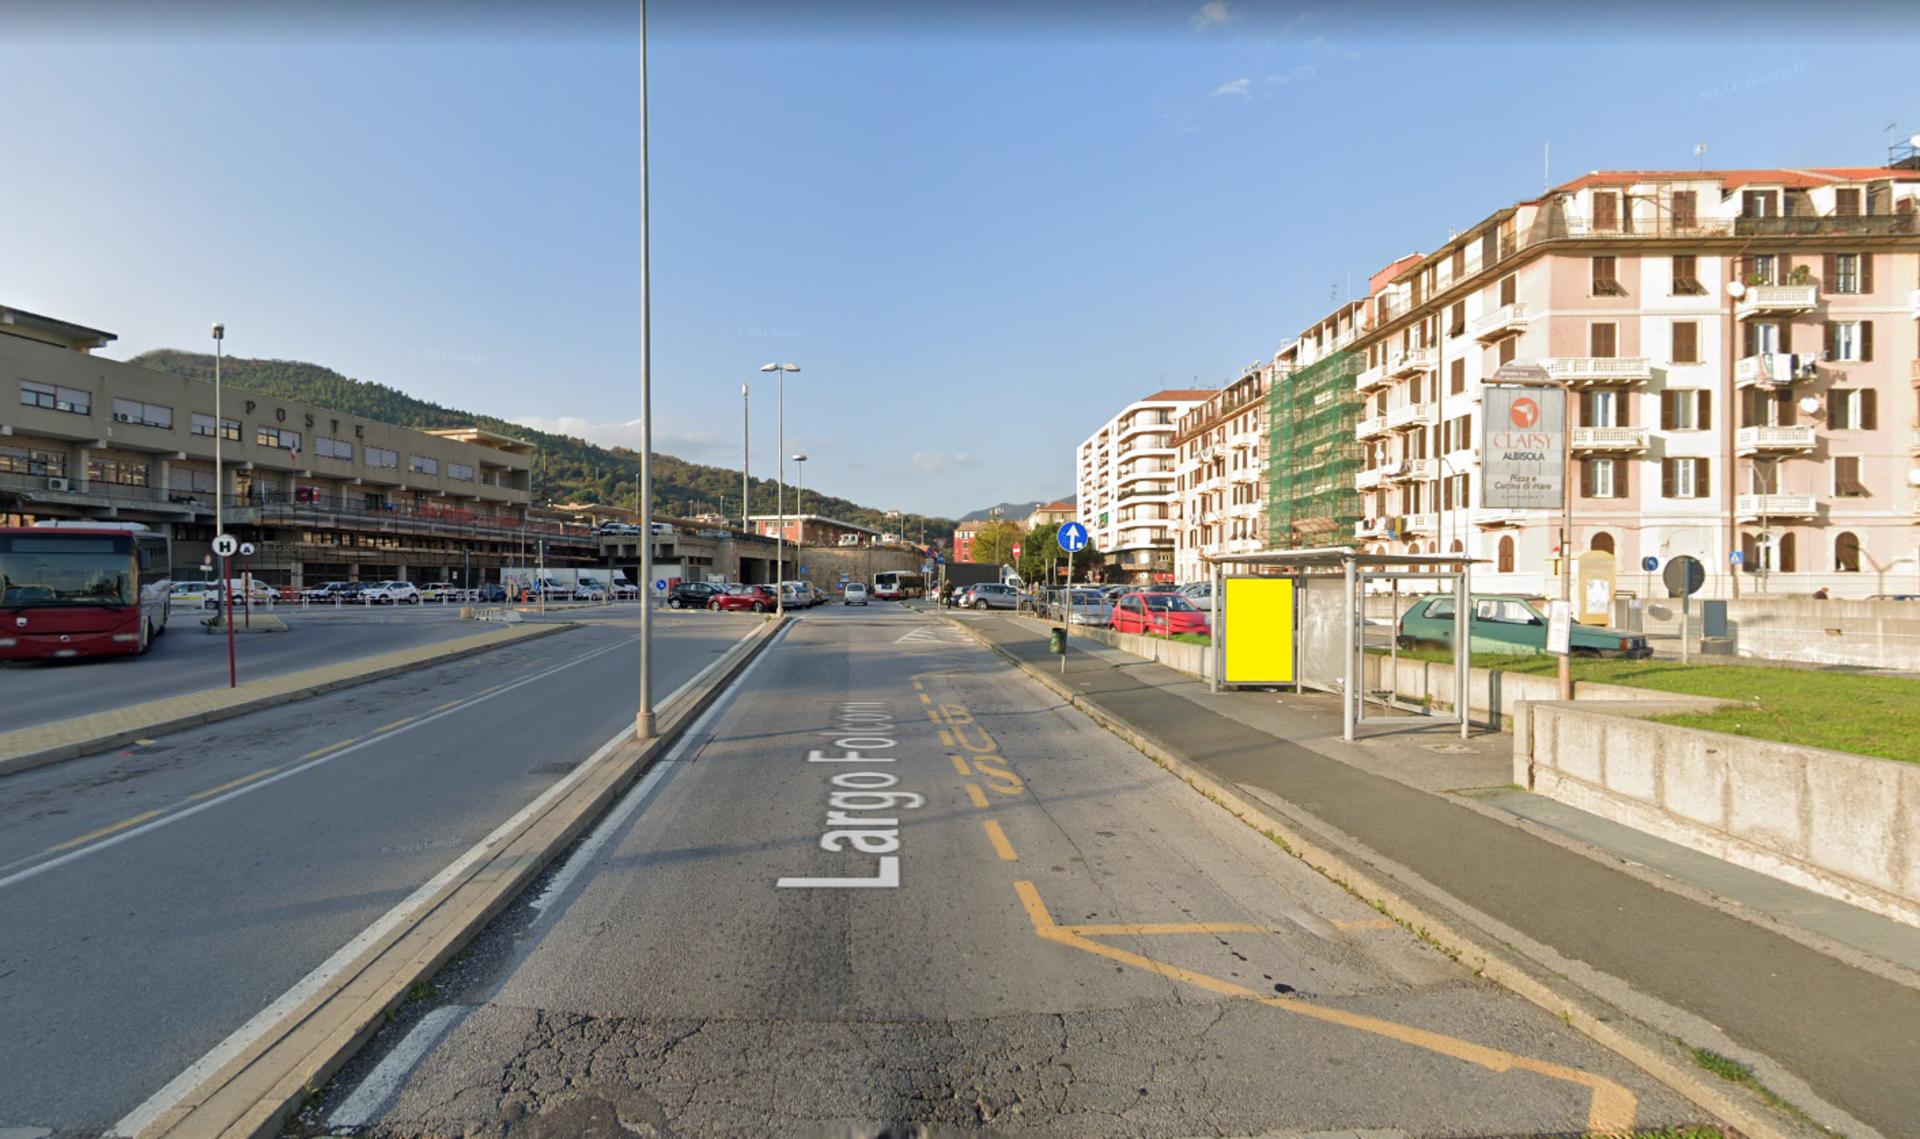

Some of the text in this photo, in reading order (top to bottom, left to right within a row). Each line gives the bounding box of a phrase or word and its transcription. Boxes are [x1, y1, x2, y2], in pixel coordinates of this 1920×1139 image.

[245, 400, 364, 439] POSTE
[1493, 432, 1552, 449] CLAPSY
[1502, 452, 1546, 461] ALBISOLA
[219, 541, 231, 553] H
[940, 703, 1025, 795] BUS
